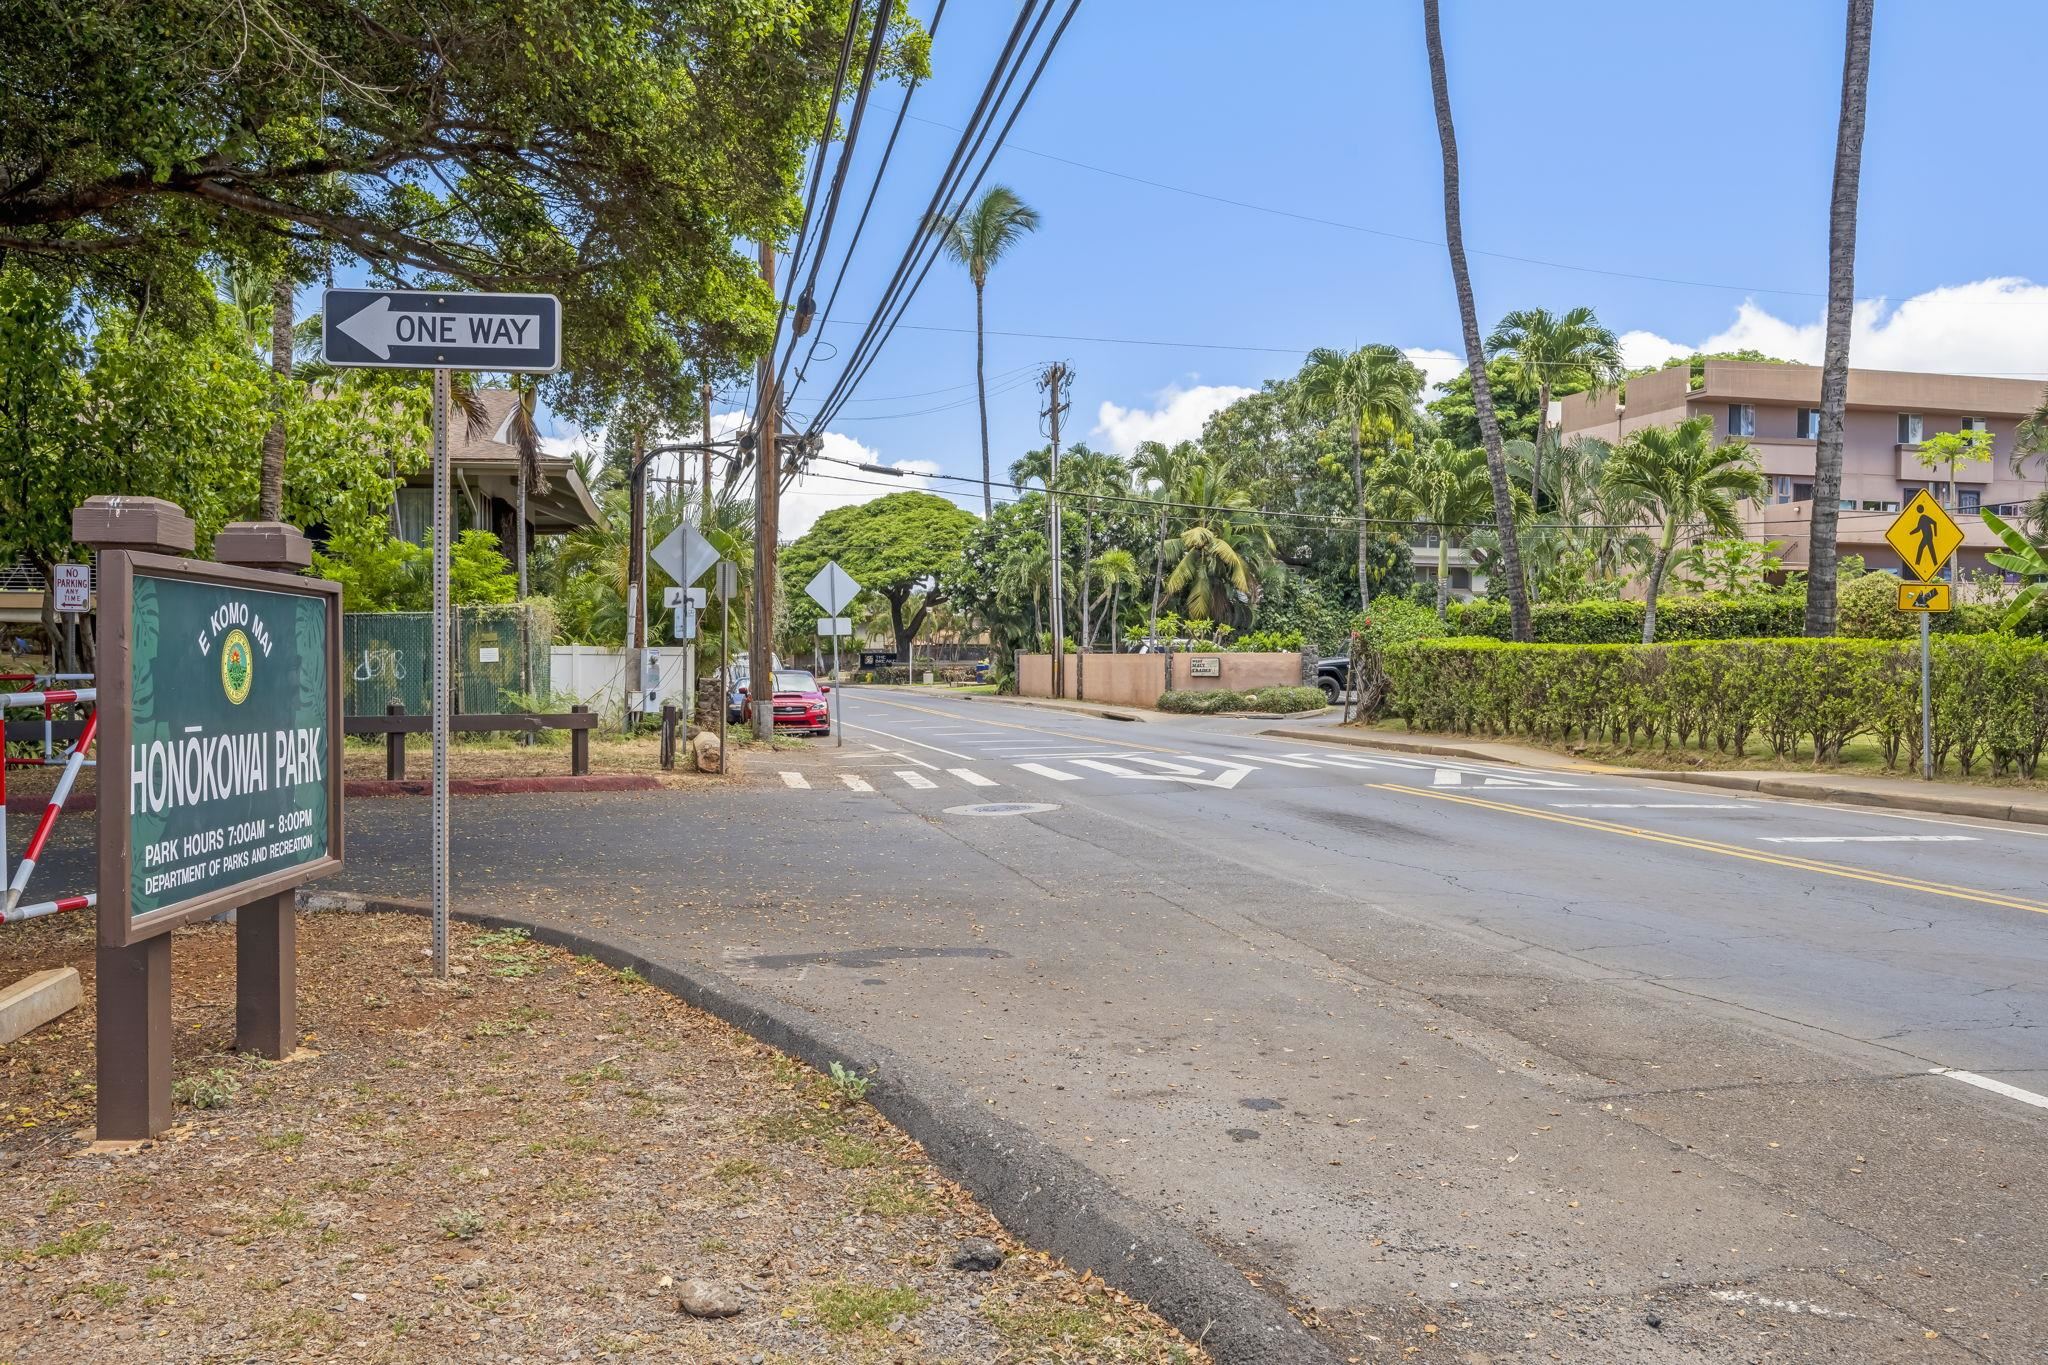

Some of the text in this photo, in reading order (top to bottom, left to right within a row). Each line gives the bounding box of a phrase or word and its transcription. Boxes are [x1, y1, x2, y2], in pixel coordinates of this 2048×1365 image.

[396, 315, 531, 345] ONE WAY
[57, 579, 87, 588] PARKING
[66, 568, 78, 577] NO
[198, 630, 210, 656] E
[210, 602, 248, 637] KOMO
[252, 614, 273, 658] MAI
[131, 726, 321, 815] HONŌKOWAI PARK
[145, 839, 179, 868] PARK
[183, 829, 224, 858] HOURS
[228, 819, 265, 846] 7:00AM
[278, 809, 312, 834] 8:00PM
[145, 834, 312, 895] DEPARTMENT OF PARKS AND RECREATION
